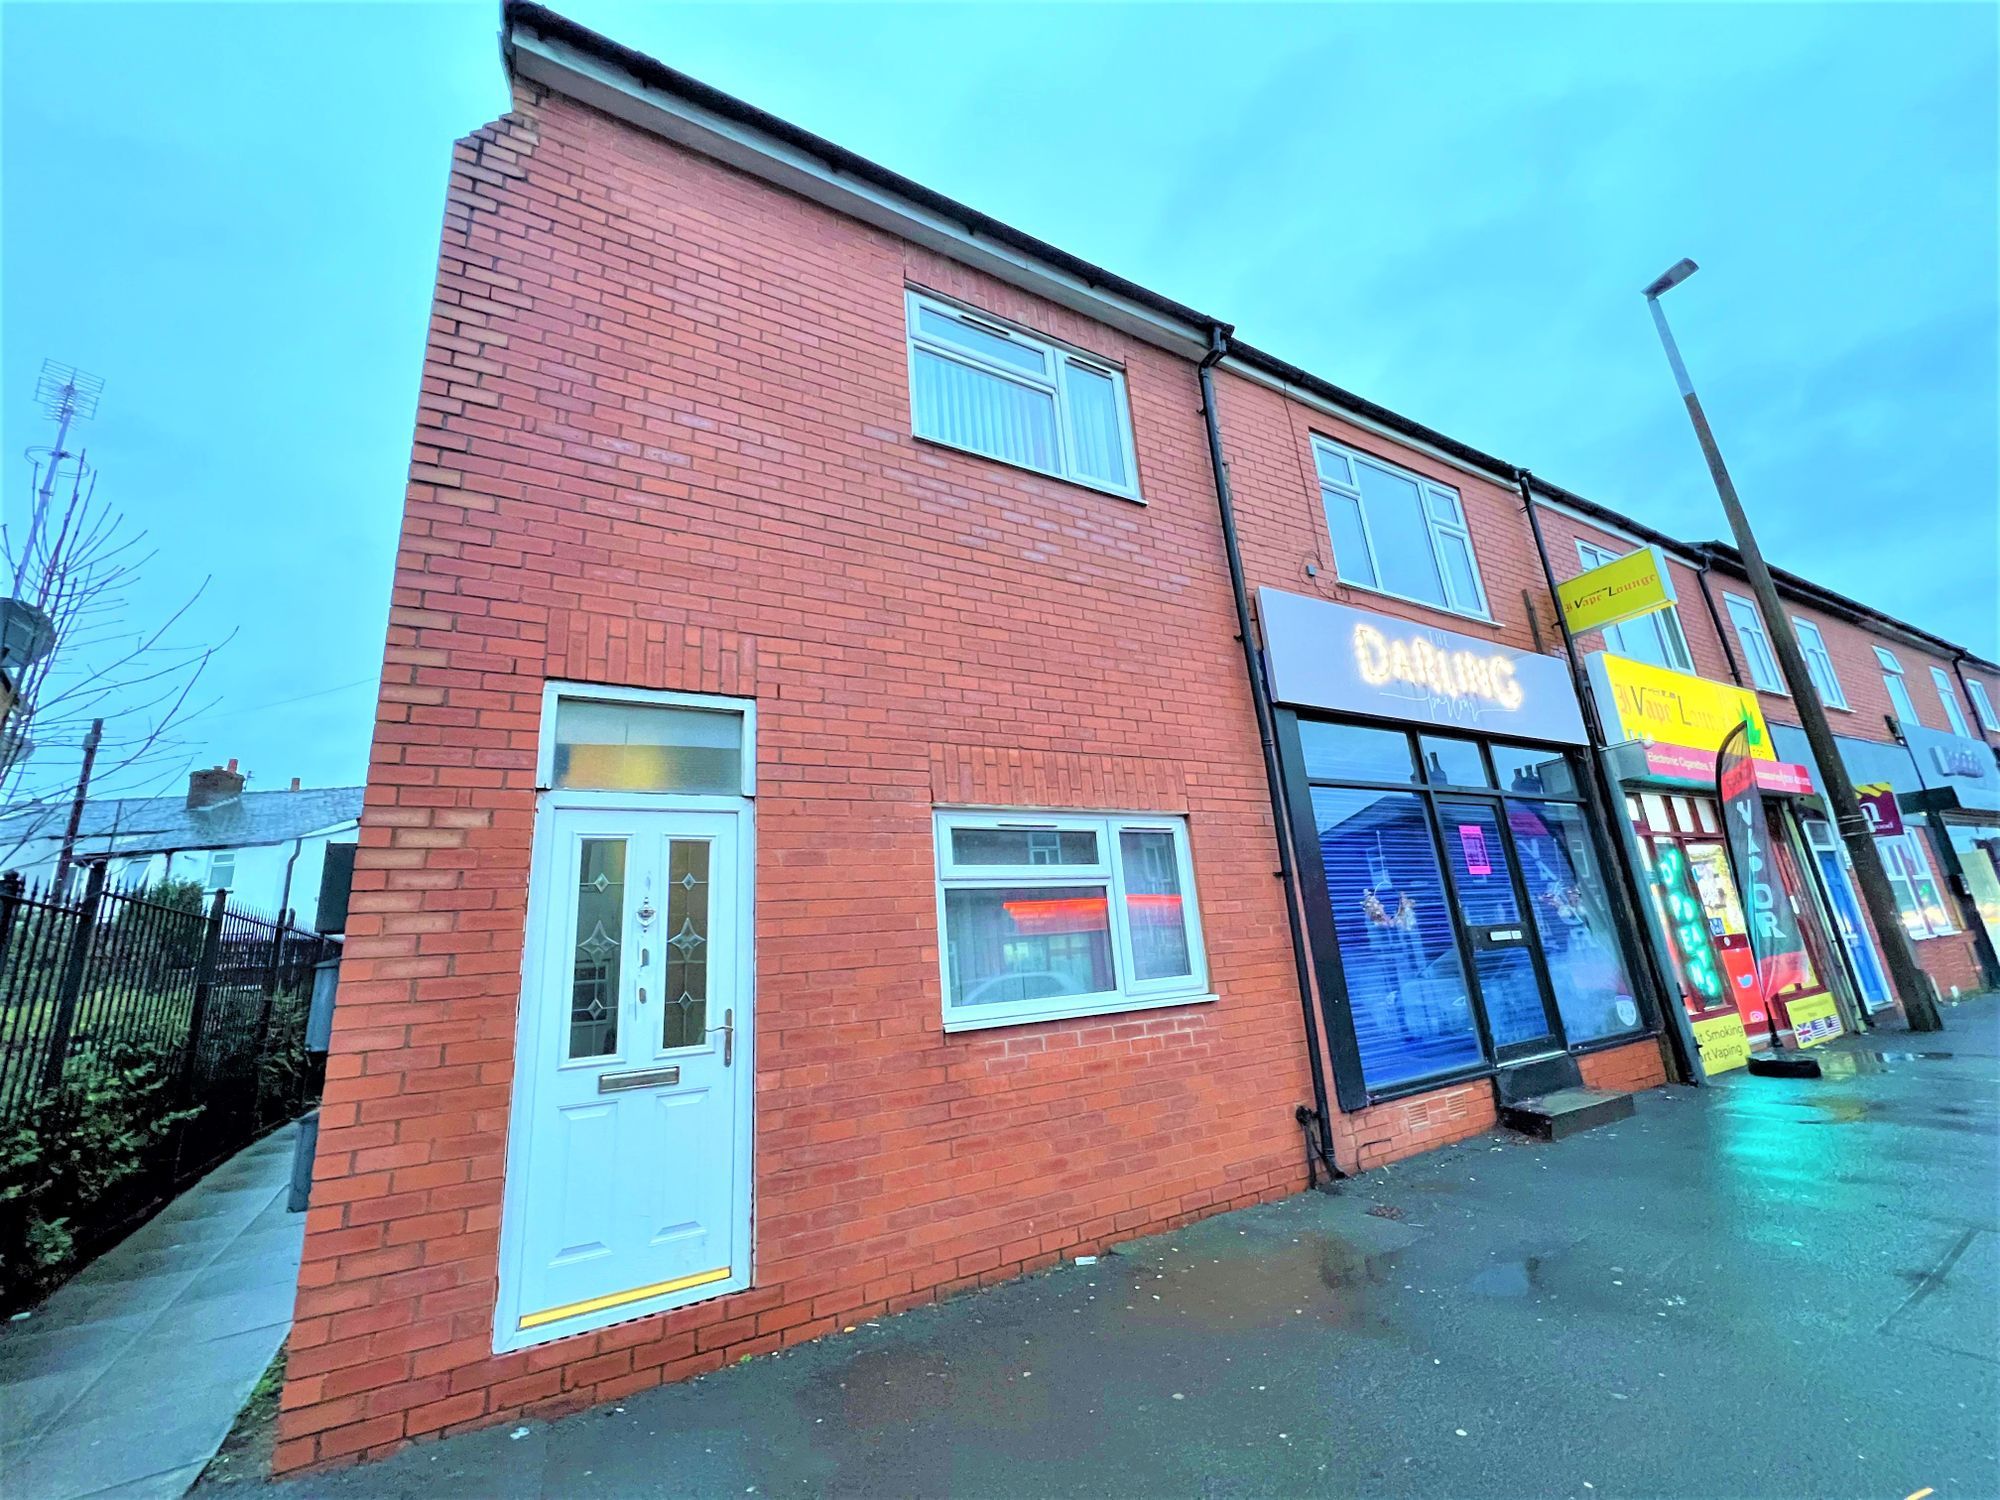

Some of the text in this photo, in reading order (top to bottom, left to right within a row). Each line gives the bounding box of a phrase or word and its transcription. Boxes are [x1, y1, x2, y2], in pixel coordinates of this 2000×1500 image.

[1608, 574, 1656, 597] Lounge
[1354, 623, 1524, 710] DARLING
[1705, 1025, 1744, 1042] Smoking
[1711, 1045, 1742, 1060] Vaping
